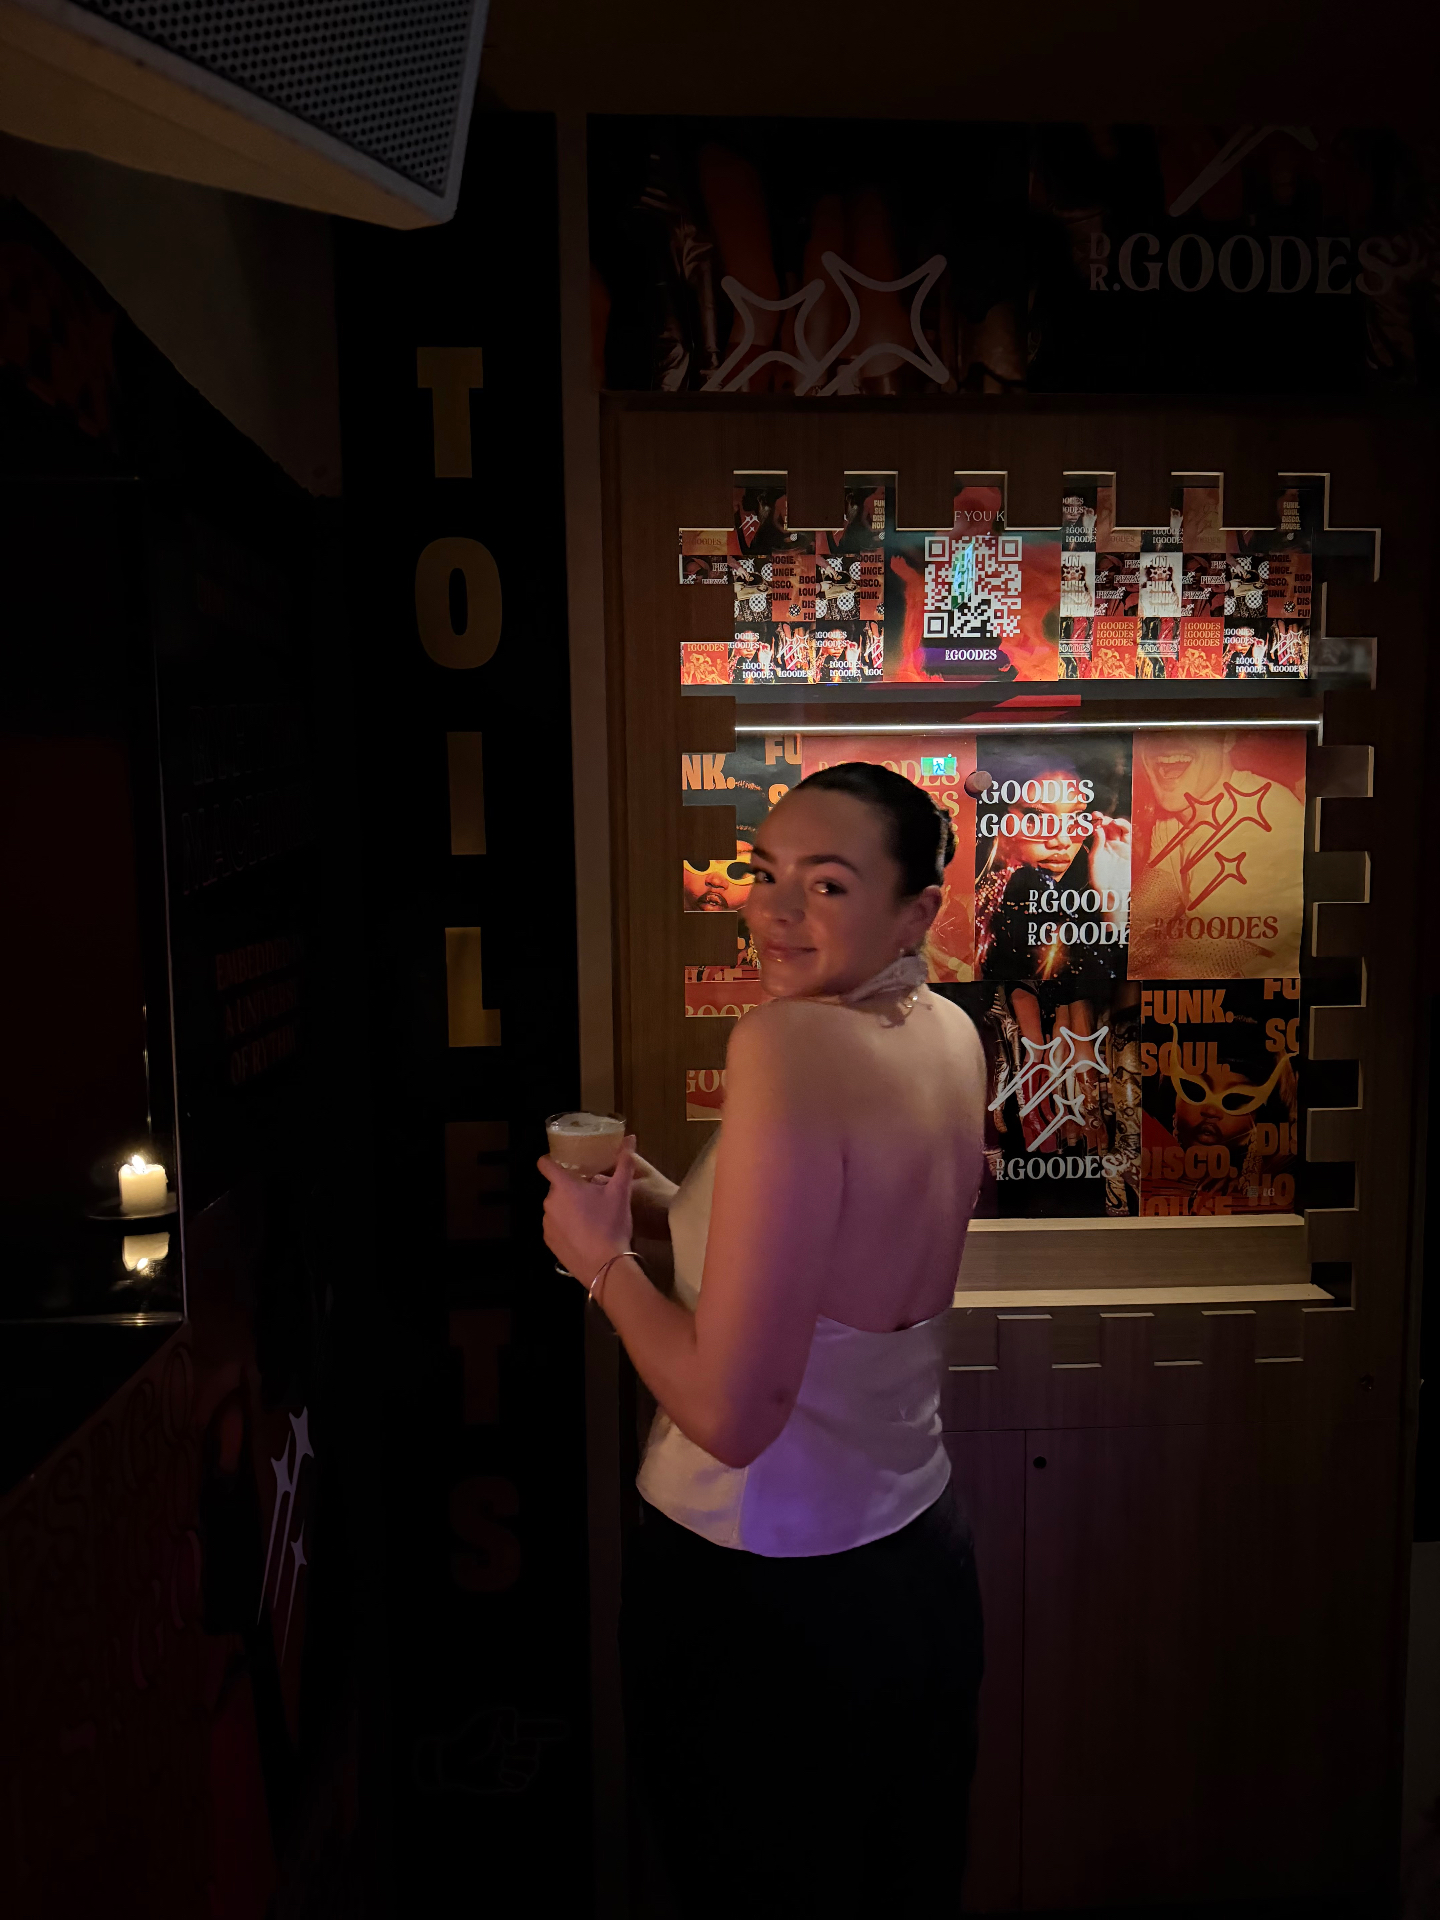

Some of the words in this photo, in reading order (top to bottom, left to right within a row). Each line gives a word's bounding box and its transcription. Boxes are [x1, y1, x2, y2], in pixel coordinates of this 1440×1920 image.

[1118, 232, 1394, 296] GOODES
[964, 510, 992, 521] YOU
[950, 649, 997, 661] GOODES
[1166, 916, 1279, 940] GOODES
[1141, 989, 1235, 1024] FUNK.
[1008, 1155, 1119, 1180] GOODES
